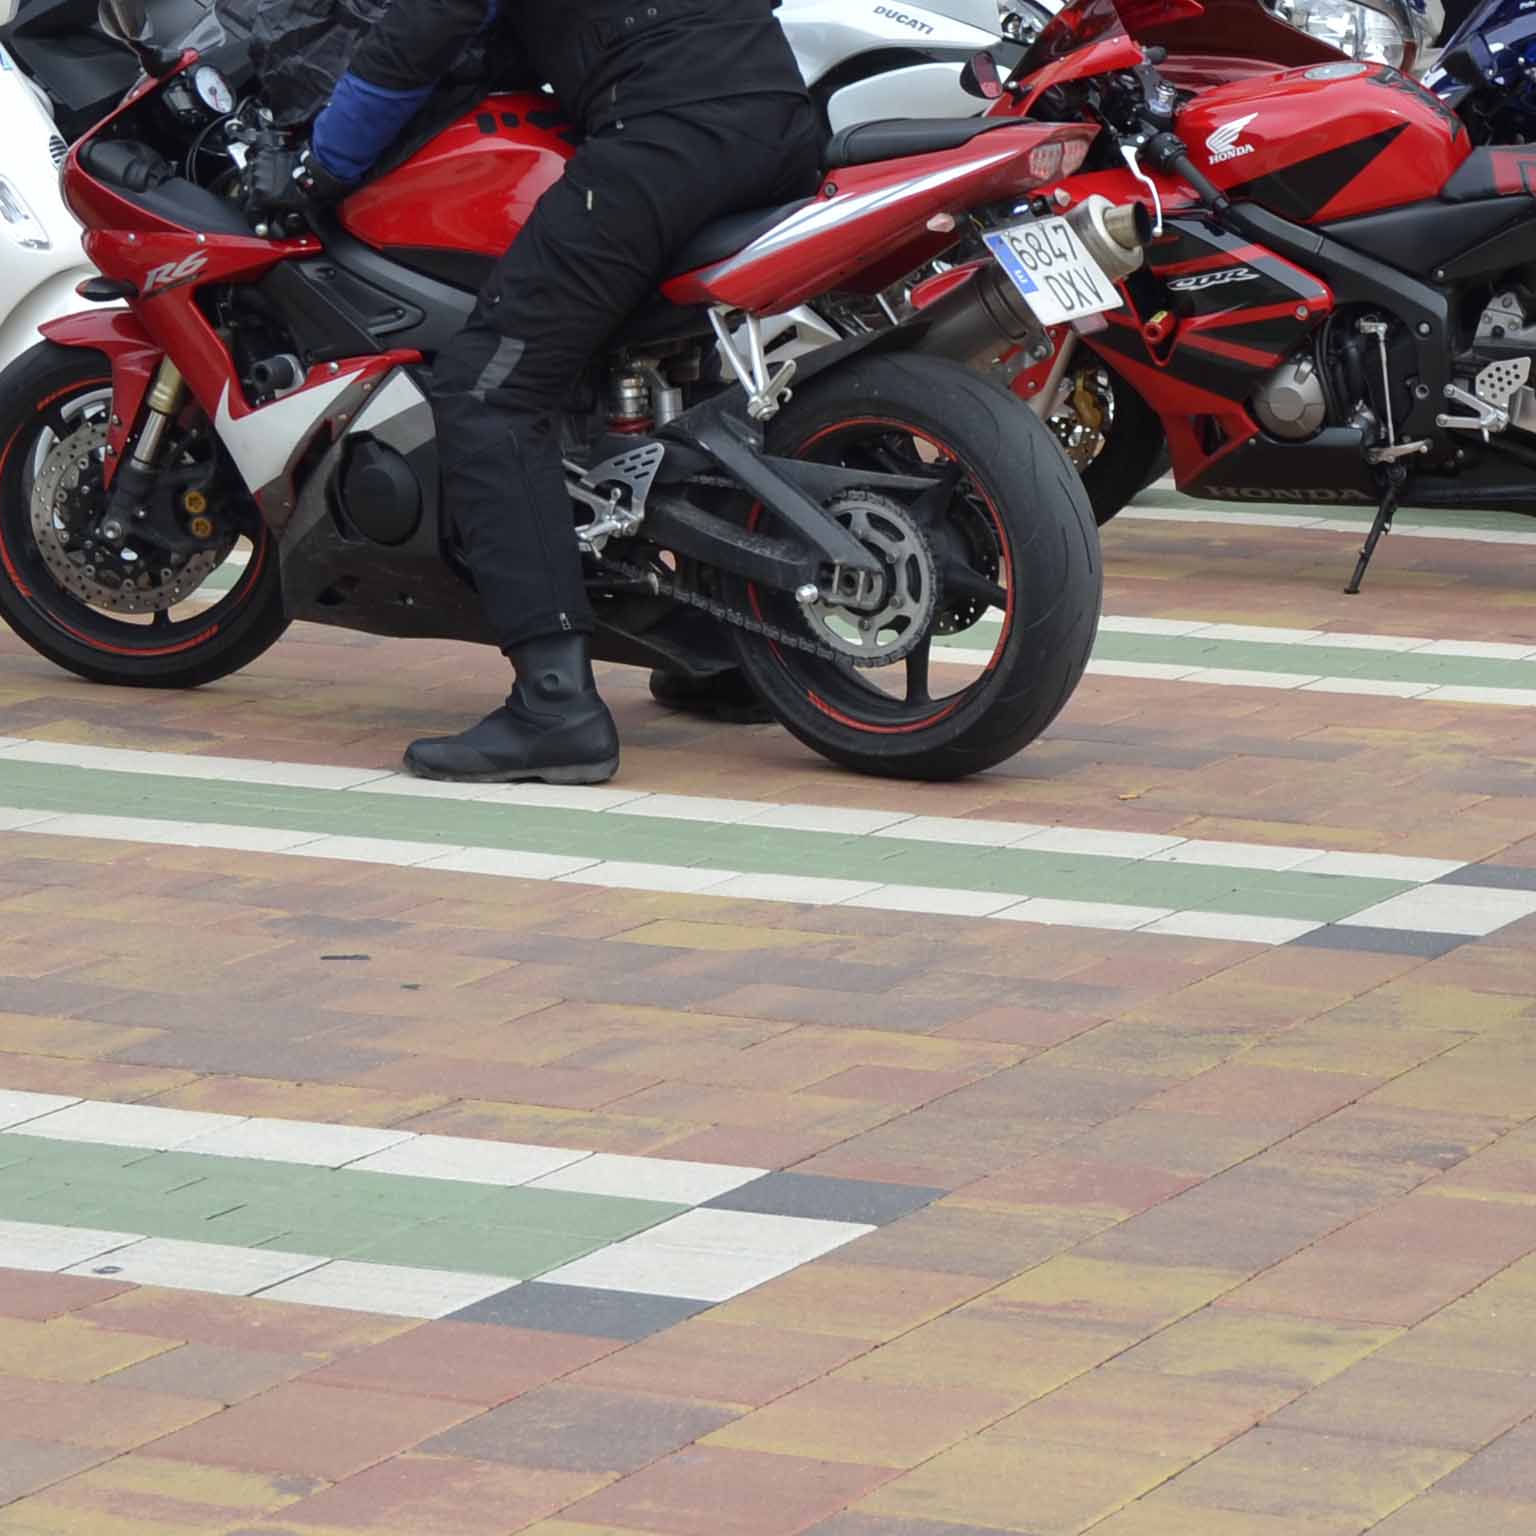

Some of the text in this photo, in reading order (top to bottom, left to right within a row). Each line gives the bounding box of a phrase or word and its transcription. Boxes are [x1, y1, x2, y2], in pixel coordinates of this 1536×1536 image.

[872, 5, 935, 35] DUCATI
[1208, 144, 1255, 165] HONDA
[1010, 224, 1079, 271] 6847
[144, 248, 208, 292] R6
[1045, 267, 1105, 312] DXV
[1203, 485, 1376, 501] HONDA
